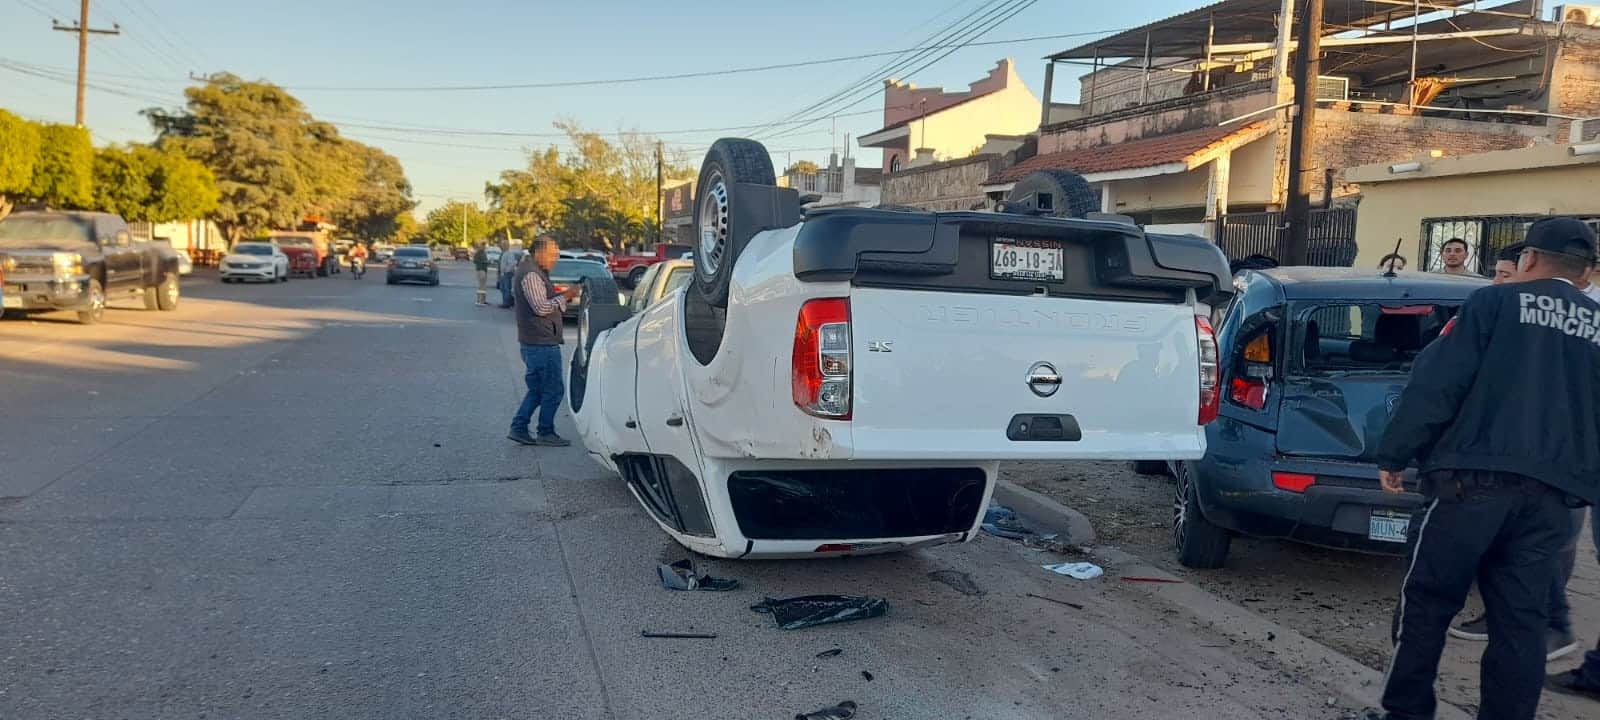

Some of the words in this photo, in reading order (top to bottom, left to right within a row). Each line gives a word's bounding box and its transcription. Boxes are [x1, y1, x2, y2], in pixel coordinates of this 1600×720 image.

[995, 249, 1063, 271] VE-81-897
[920, 304, 1147, 332] FRONTIER
[868, 341, 893, 352] SE
